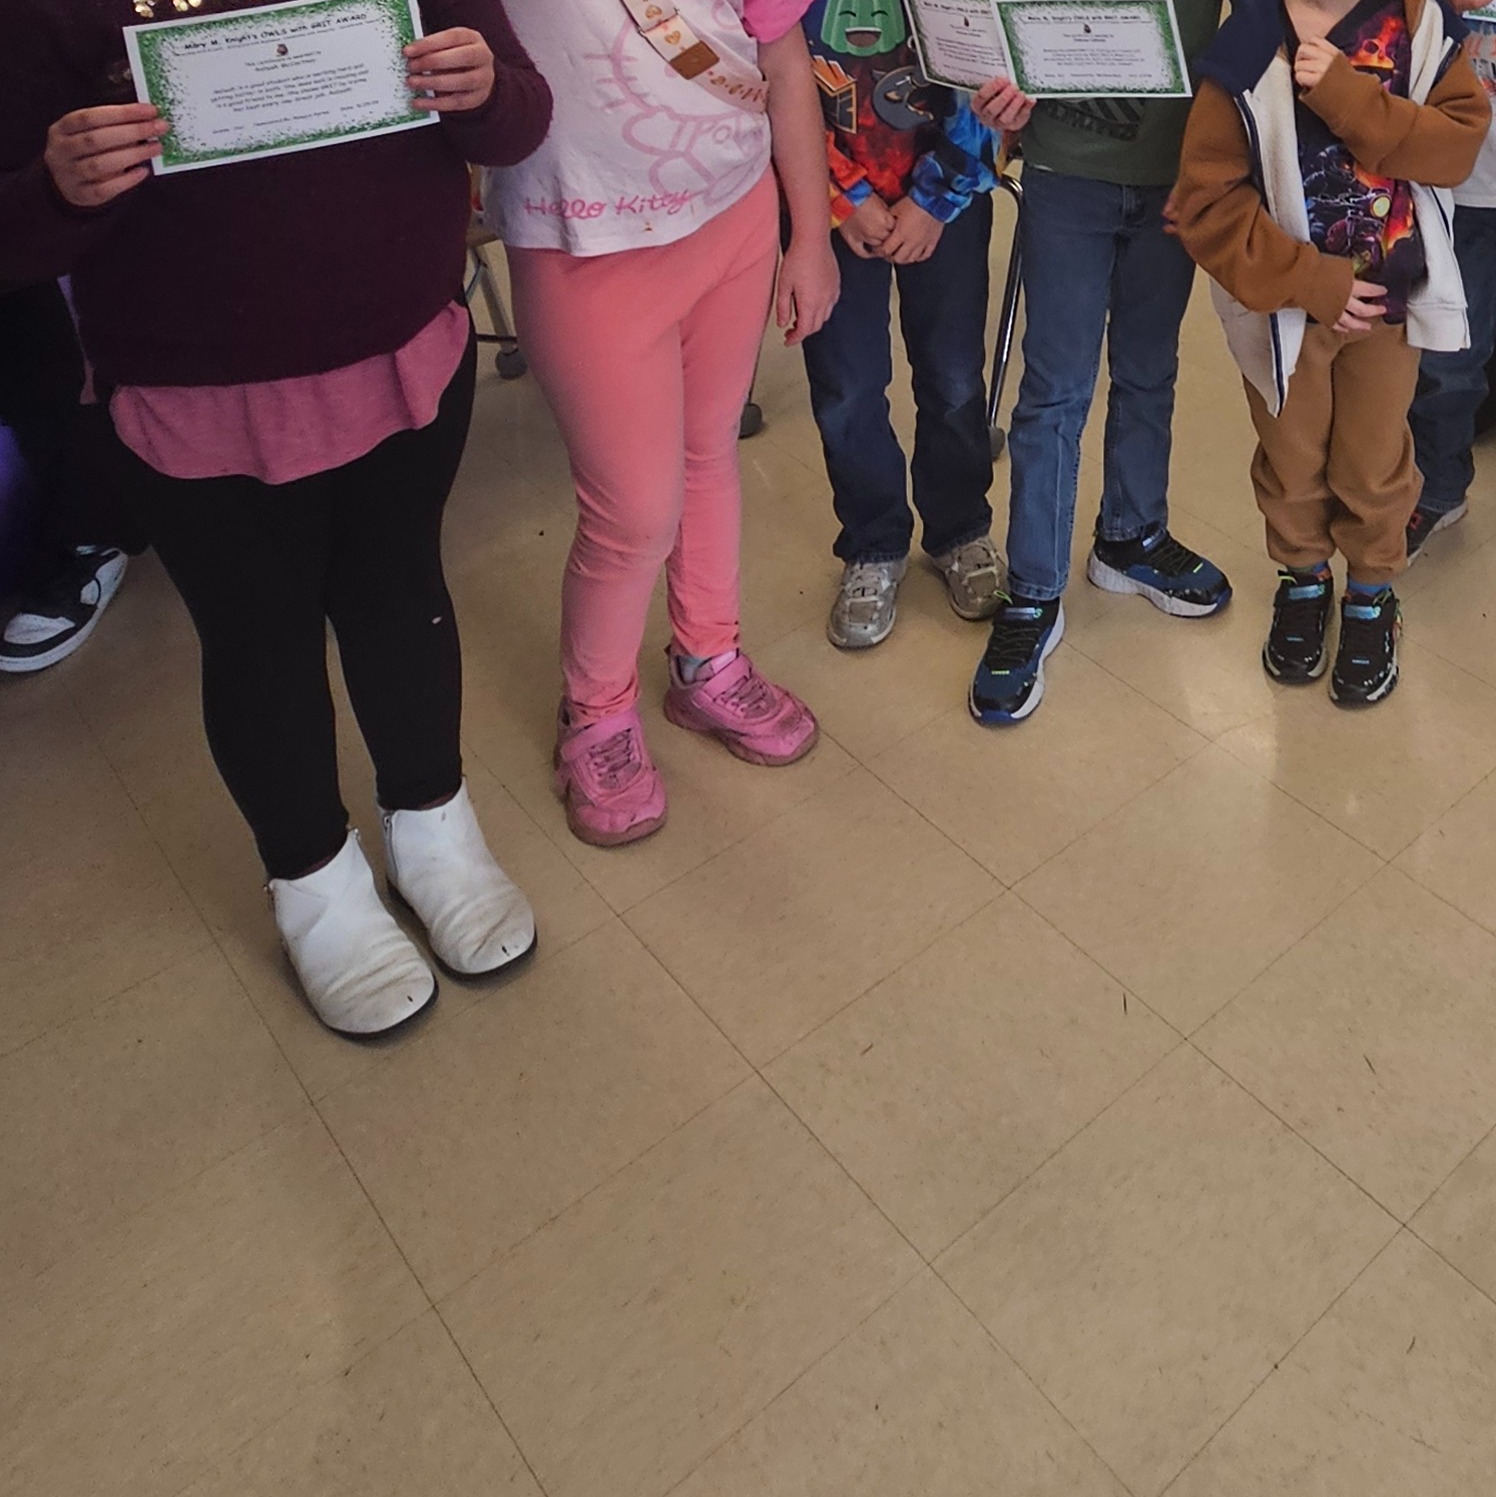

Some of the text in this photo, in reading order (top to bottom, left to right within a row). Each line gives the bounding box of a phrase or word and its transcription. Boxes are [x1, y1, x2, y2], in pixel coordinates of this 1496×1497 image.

[184, 41, 207, 50] Mary
[291, 25, 307, 34] with
[311, 19, 332, 30] GRIT
[336, 14, 367, 24] AWARD
[524, 189, 689, 220] Hello Kitty
